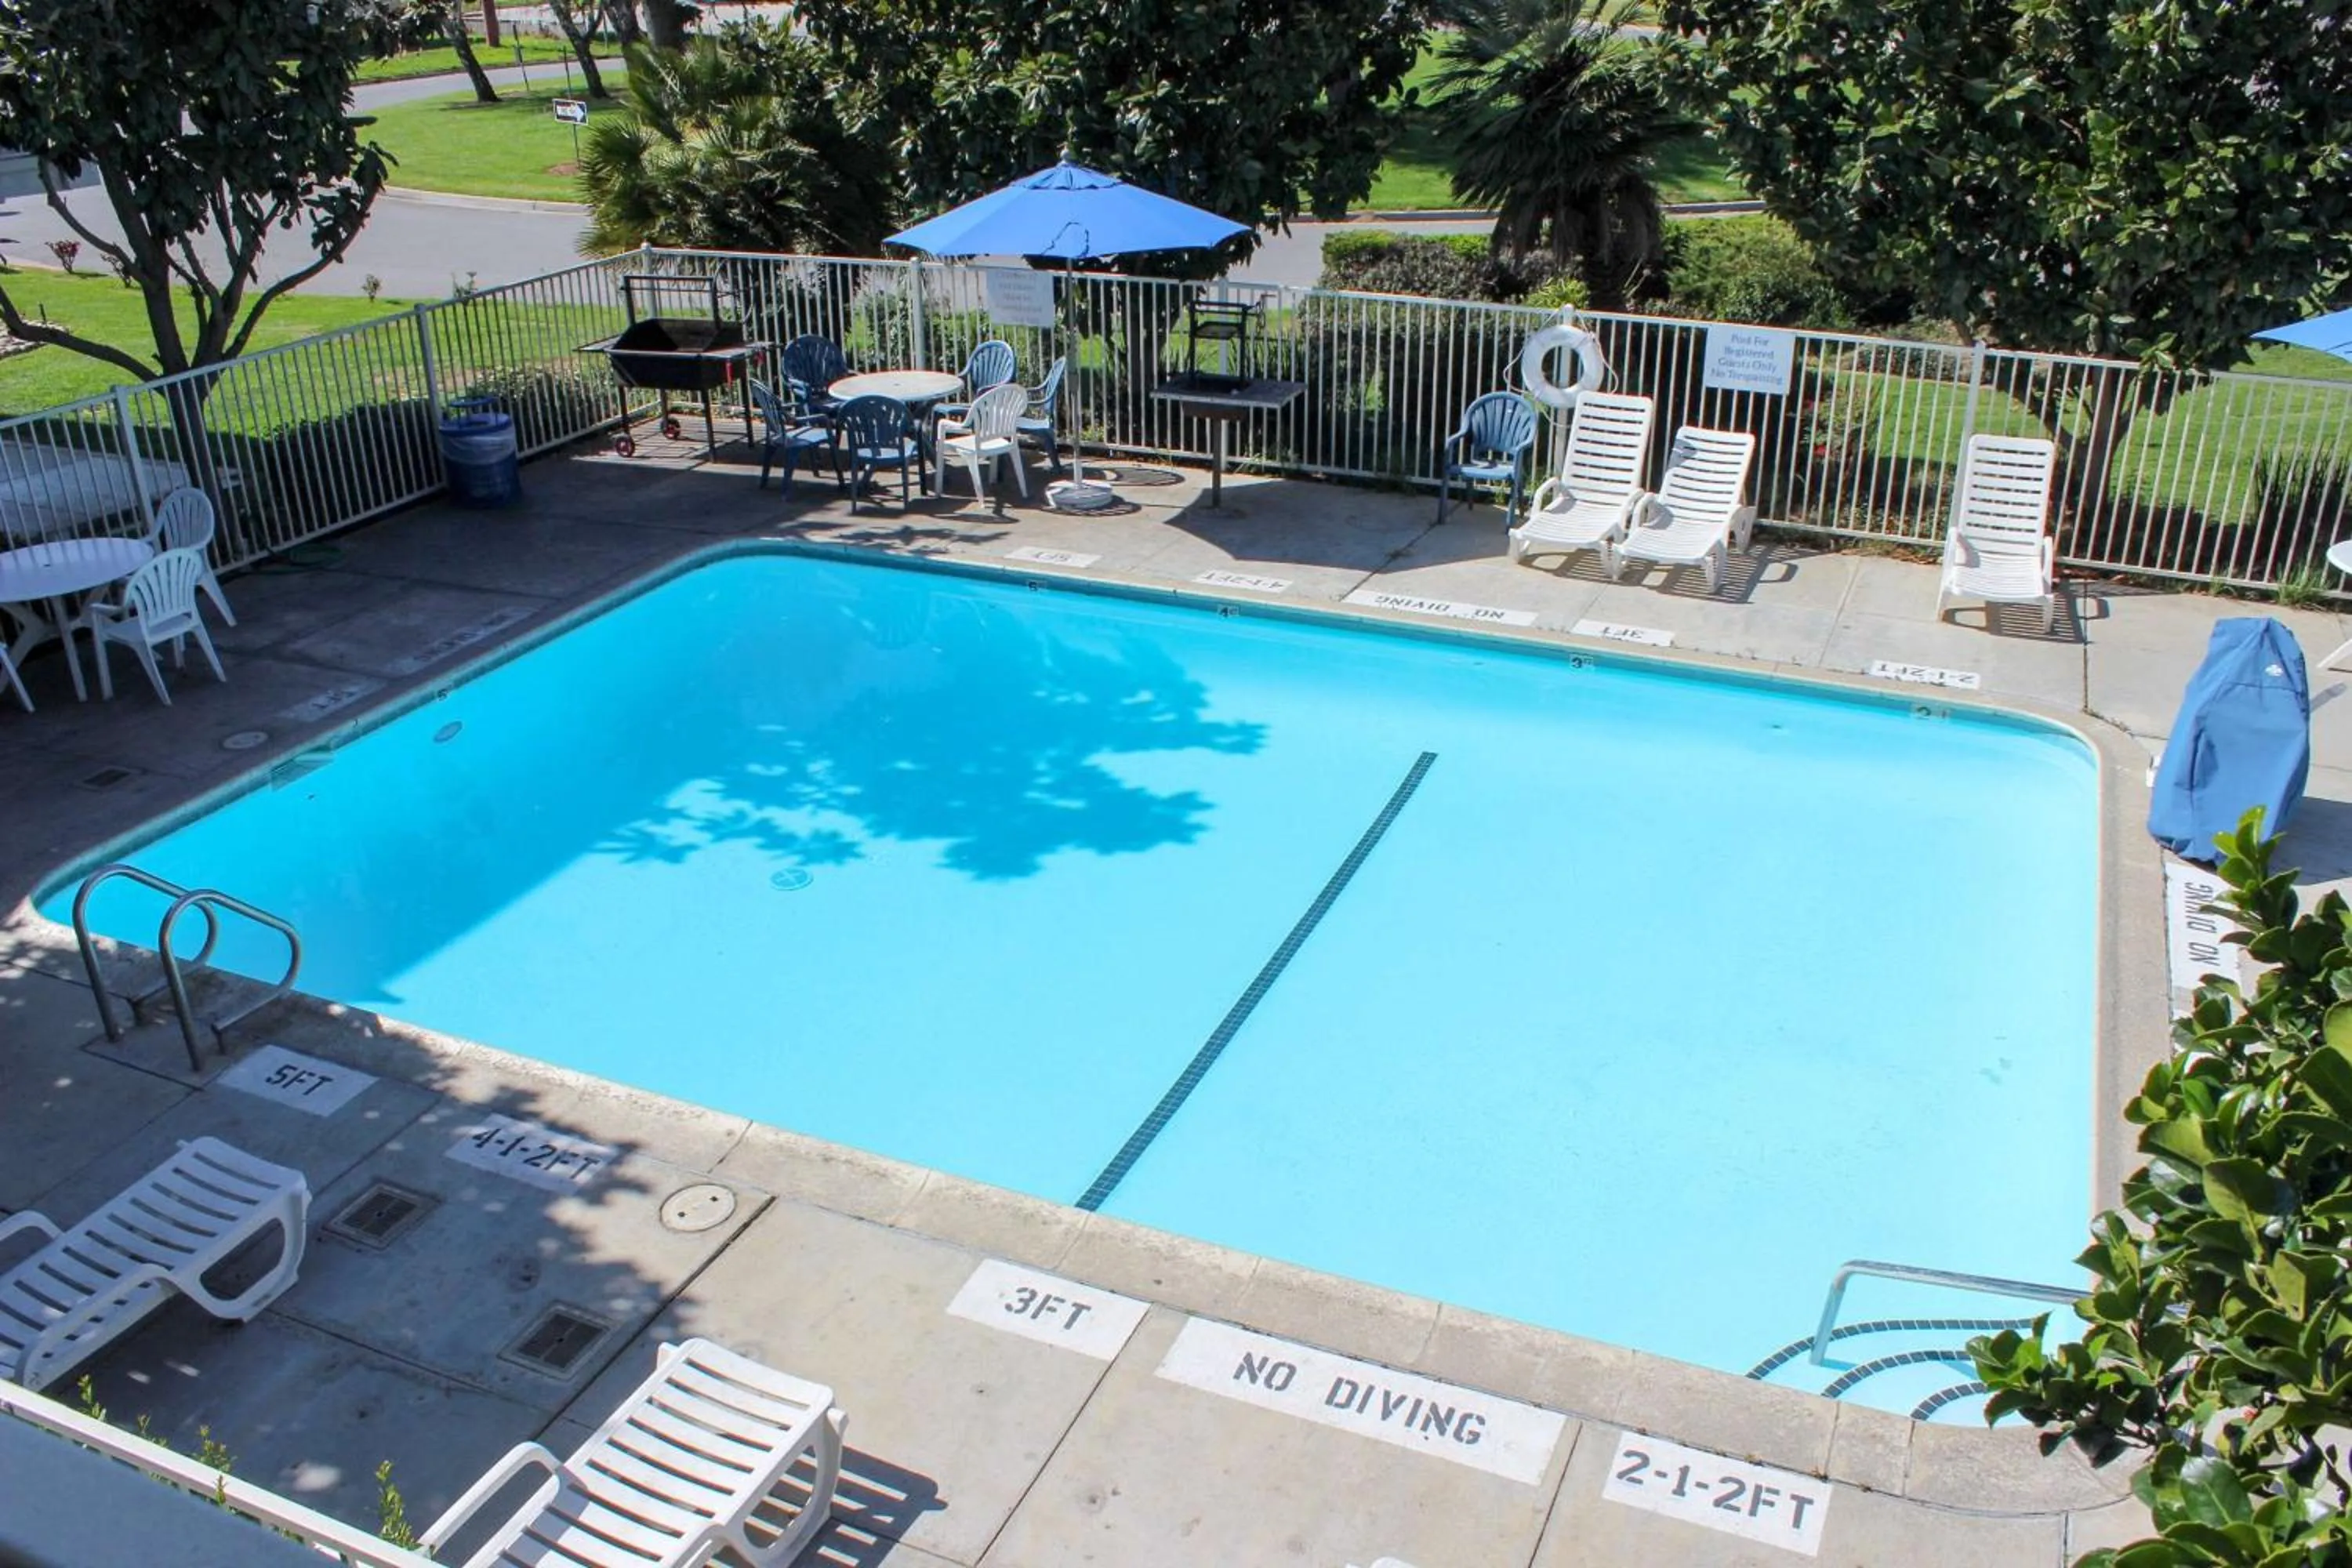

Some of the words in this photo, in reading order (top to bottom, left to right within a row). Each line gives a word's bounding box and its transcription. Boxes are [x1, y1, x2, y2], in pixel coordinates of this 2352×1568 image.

[1754, 336, 1769, 346] For
[1718, 358, 1751, 368] Guests
[1752, 361, 1777, 373] Only
[1375, 595, 1450, 612] DIVING
[1474, 608, 1504, 619] NO
[2188, 942, 2221, 967] NO
[266, 1064, 333, 1096] 5FT
[472, 1128, 601, 1179] 4-1-2FT
[1004, 1287, 1091, 1330] 3FT
[1232, 1352, 1298, 1392] NO
[1325, 1377, 1486, 1445] DIVING
[1616, 1450, 1814, 1529] 2-1-2FT
